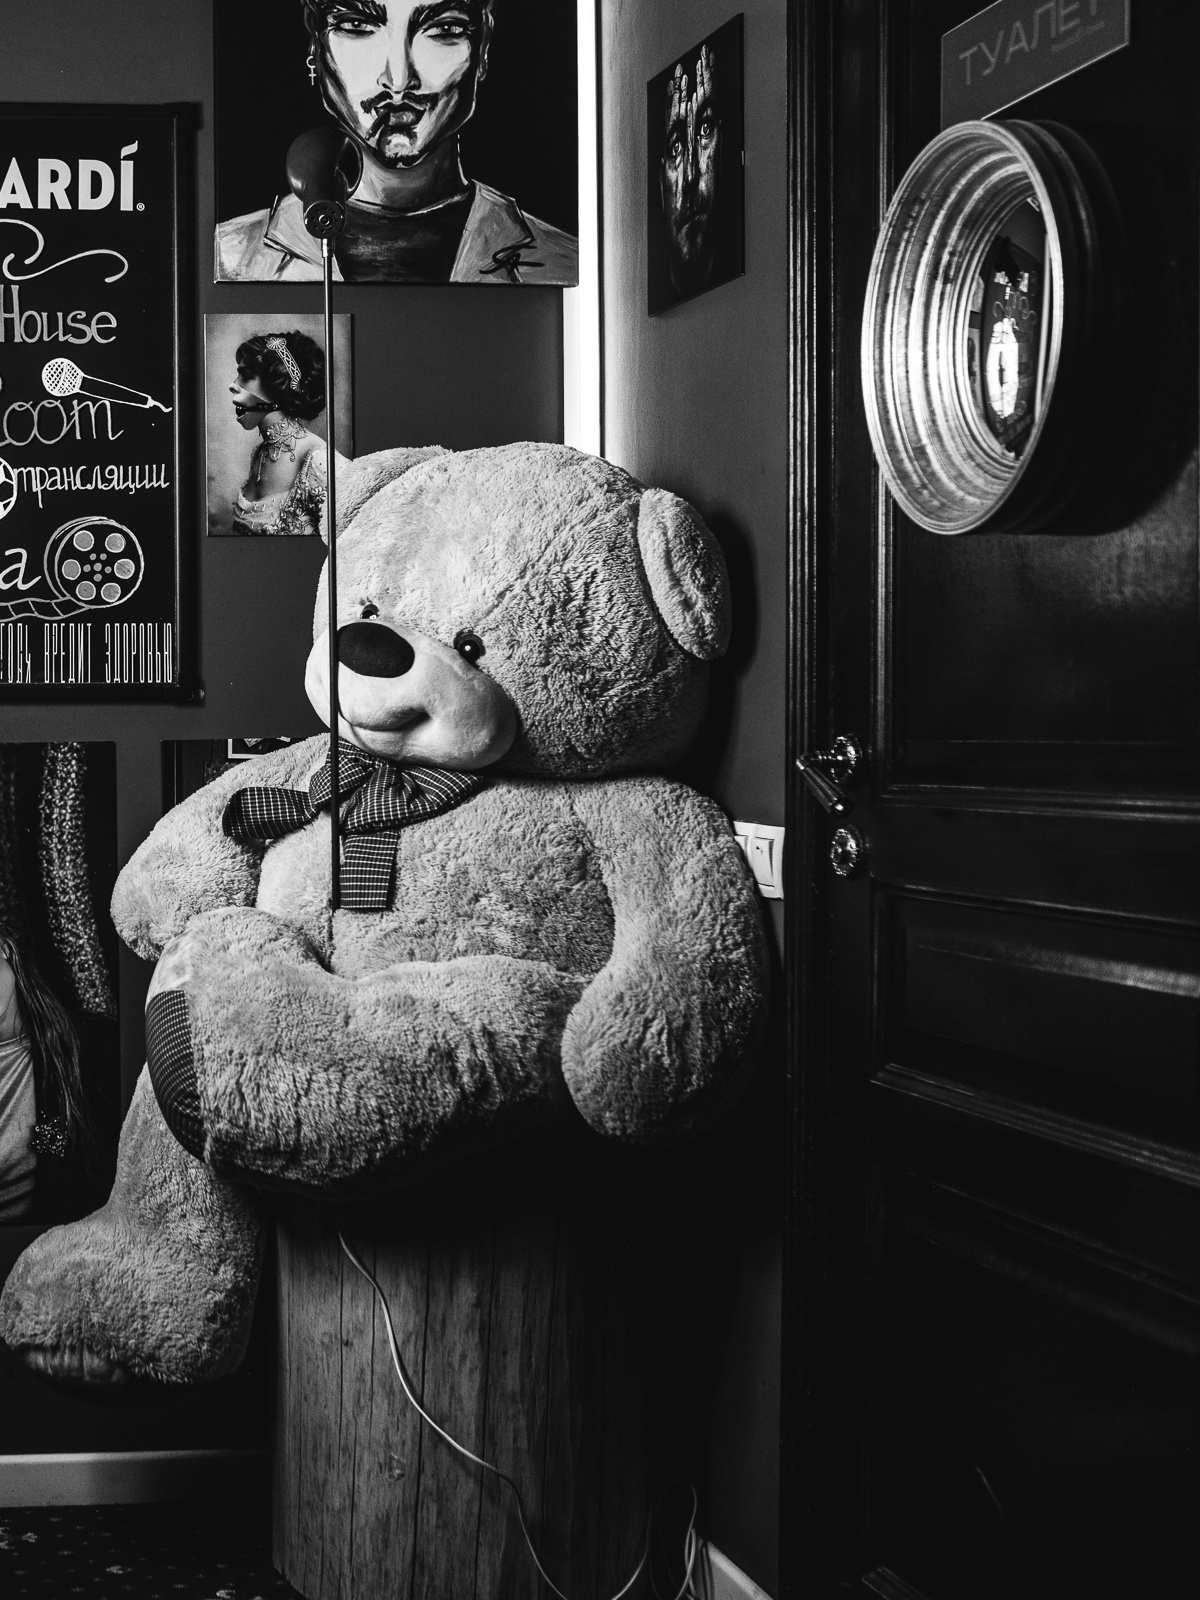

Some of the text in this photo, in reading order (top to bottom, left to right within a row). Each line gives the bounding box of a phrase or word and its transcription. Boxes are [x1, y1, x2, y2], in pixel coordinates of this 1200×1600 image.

[12, 463, 170, 509] трансляции
[44, 622, 92, 684] ВРЕДИТ
[105, 622, 173, 684] ЗДОРОВЬЮ
